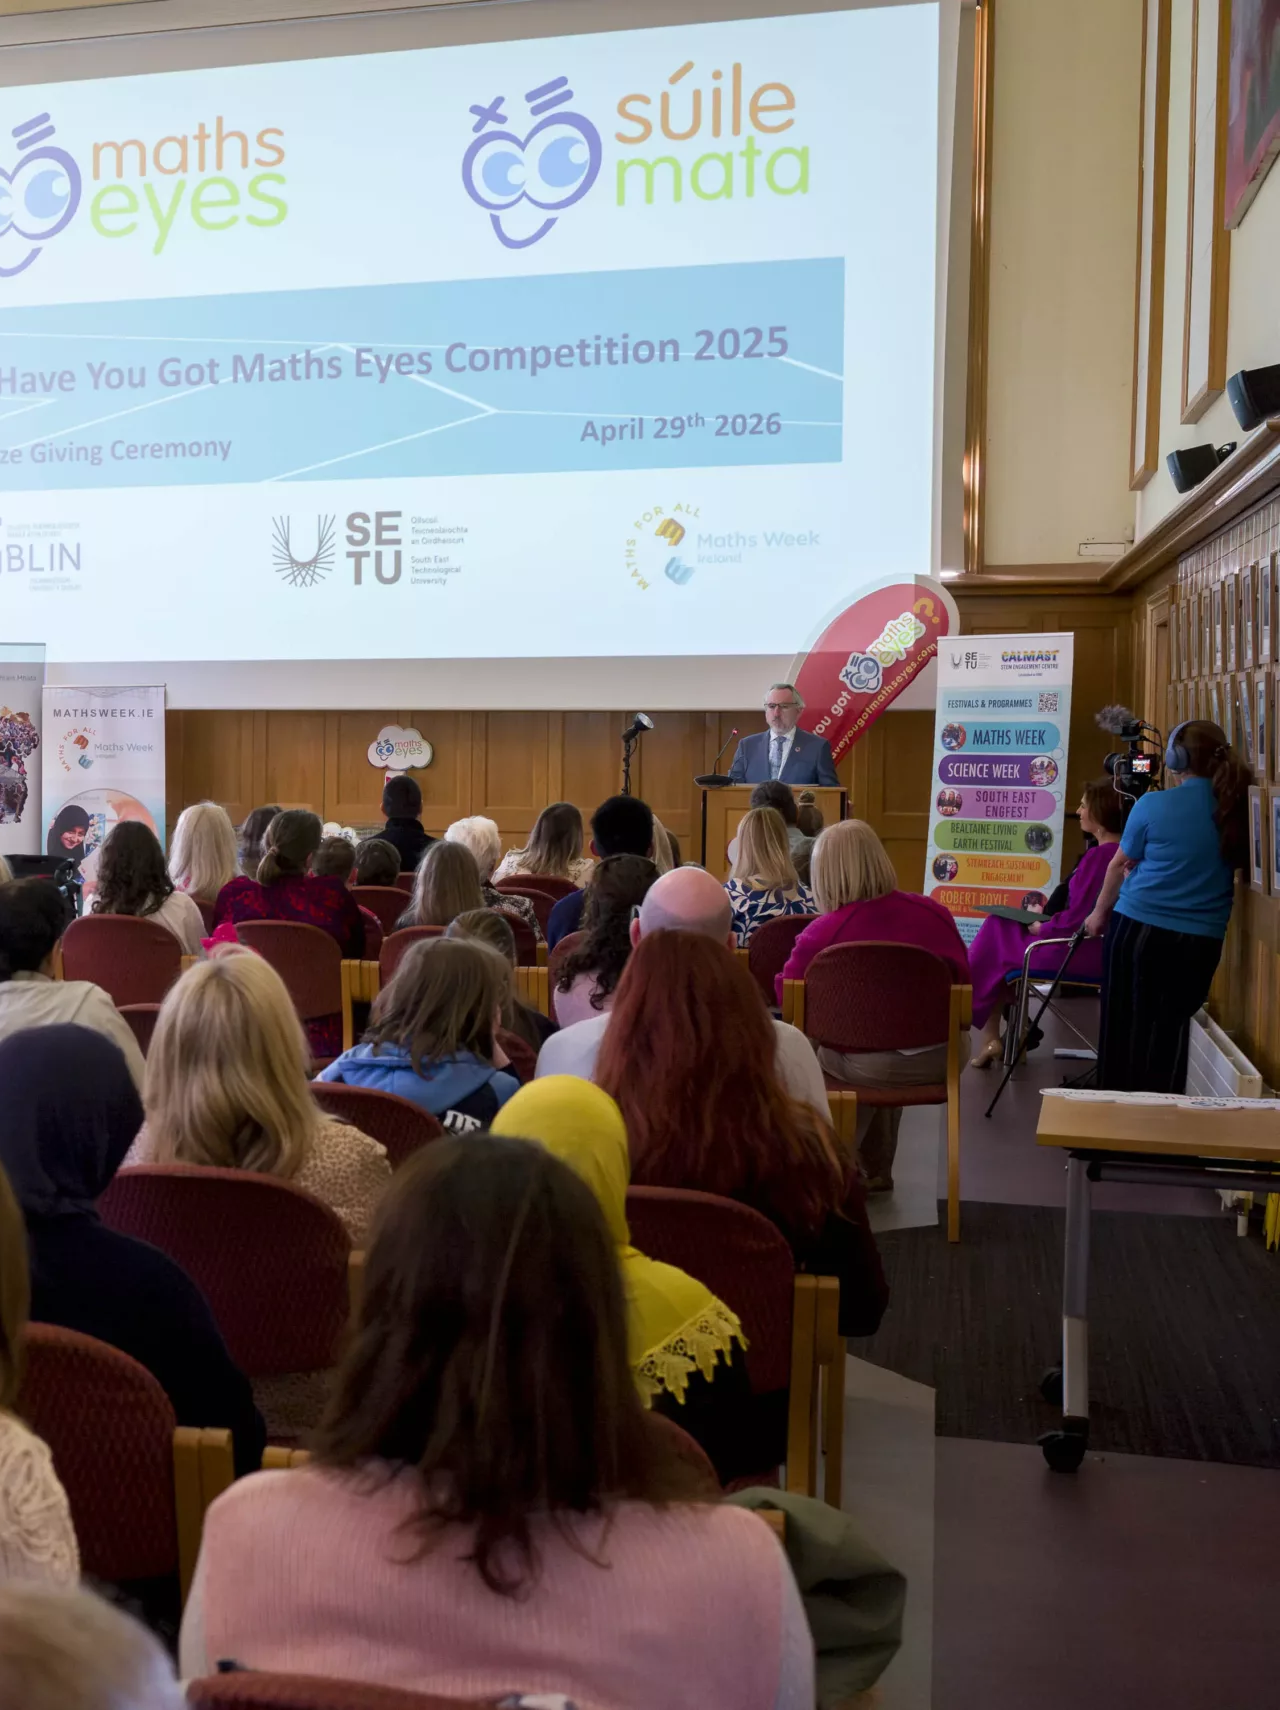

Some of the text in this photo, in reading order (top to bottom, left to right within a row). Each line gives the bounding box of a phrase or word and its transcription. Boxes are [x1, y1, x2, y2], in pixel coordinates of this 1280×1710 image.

[614, 61, 796, 145] súile
[92, 115, 286, 181] maths
[616, 135, 810, 207] mata
[89, 172, 289, 256] eyes
[85, 361, 147, 391] You
[157, 356, 220, 387] Got
[231, 349, 342, 384] Maths
[355, 347, 432, 384] Eyes
[445, 333, 680, 377] Competition
[693, 326, 789, 362] 2025
[580, 412, 782, 446] April 29th 2026
[30, 441, 103, 466] Giving
[110, 439, 232, 463] Ceremony
[625, 502, 701, 590] MATHS FOR ALL
[697, 530, 821, 549] Maths Week
[411, 555, 449, 564] South East
[411, 566, 461, 575] Technological
[410, 577, 447, 586] University
[870, 614, 913, 657] maths
[879, 622, 923, 665] eyes
[964, 652, 978, 660] SE
[1001, 649, 1060, 663] CALMAST
[964, 661, 978, 669] TU
[830, 690, 851, 717] got
[947, 699, 1033, 708] FESTIVALS & PROGRAMMES
[53, 709, 154, 718] MATHSWEEK.IE
[394, 740, 422, 748] maths
[972, 729, 1046, 746] MATHS WEEK
[59, 727, 97, 772] MATHS FOR ALL
[94, 743, 153, 752] Maths Week
[394, 746, 423, 759] eyes
[947, 763, 1020, 779] SCIENCE WEEK
[975, 790, 1037, 804] SOUTH EAST
[985, 805, 1029, 818] ENGFEST
[950, 822, 1018, 836] BEALTAINE LIVING
[953, 838, 1013, 851] EARTH FESTIVAL
[940, 890, 977, 905] ROBERT
